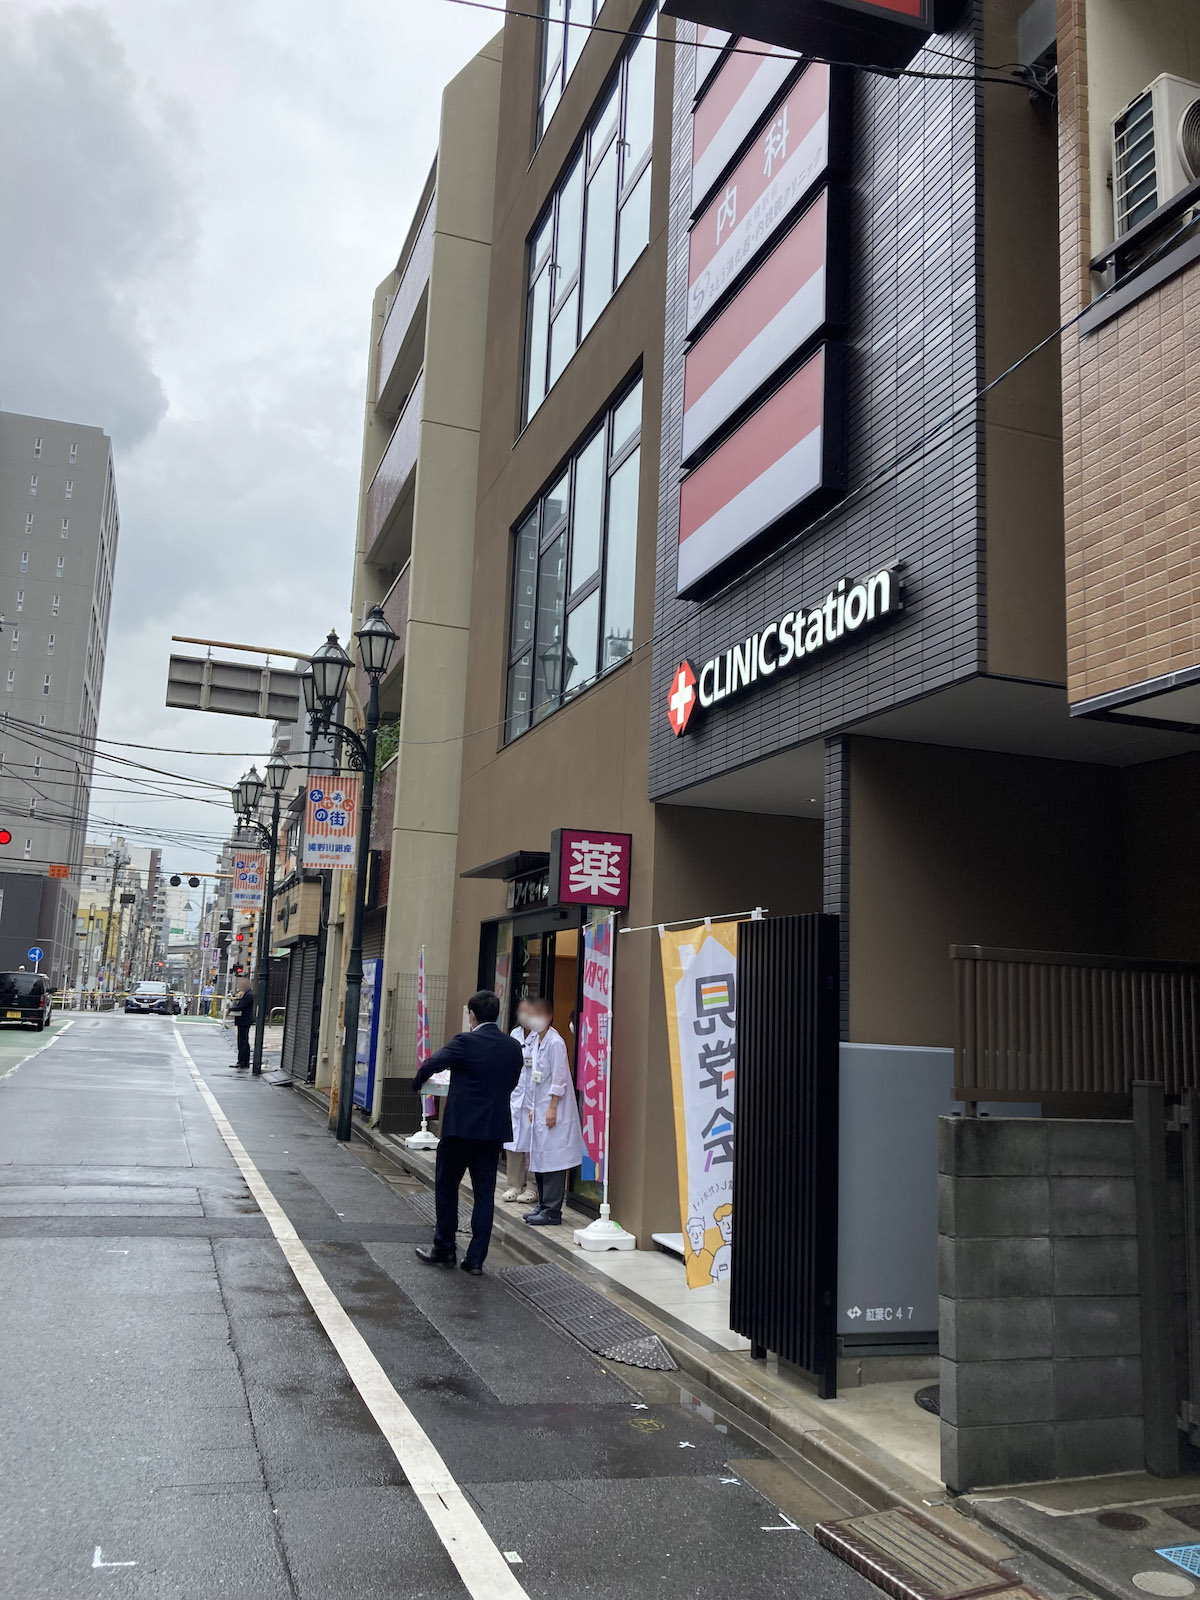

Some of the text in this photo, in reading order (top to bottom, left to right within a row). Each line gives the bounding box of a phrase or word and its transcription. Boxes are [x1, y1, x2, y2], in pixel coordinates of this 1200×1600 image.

[716, 104, 790, 246] 内科
[311, 791, 353, 810] ふれあい
[316, 811, 346, 827] の街
[569, 840, 621, 896] 薬
